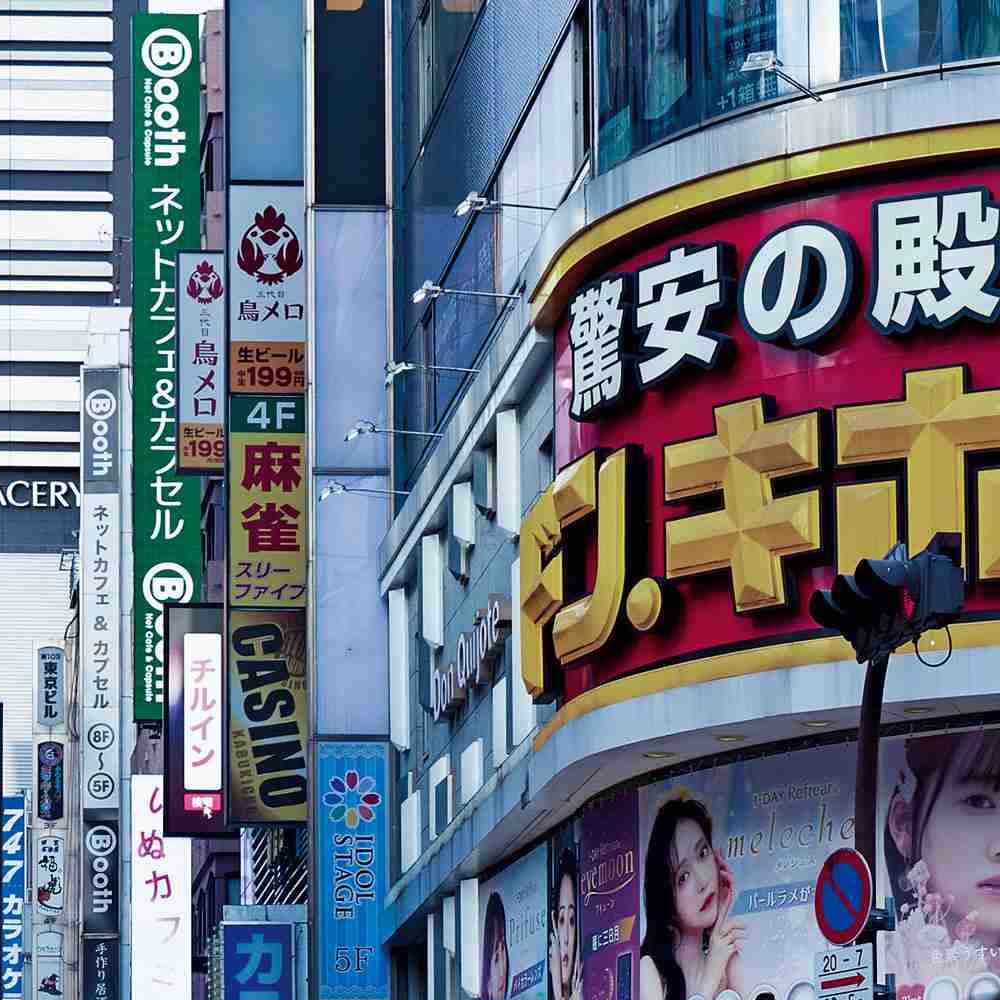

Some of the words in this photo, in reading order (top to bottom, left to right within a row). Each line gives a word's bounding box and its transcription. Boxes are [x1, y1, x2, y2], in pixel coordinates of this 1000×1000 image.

[141, 28, 193, 167] Booth
[237, 300, 304, 322] 鳥メロ
[570, 191, 1000, 420] 驚安の殿
[192, 340, 218, 417] 鳥メロ
[237, 347, 304, 363] 生ビール
[85, 389, 117, 476] Booth
[246, 401, 296, 429] 4F
[241, 441, 302, 552] 麻雀
[92, 504, 110, 606] ネットカフェ
[235, 562, 291, 578] スリー
[44, 661, 57, 719] 東京ビル
[93, 640, 110, 709] カプセル
[92, 730, 109, 744] 8F
[190, 658, 216, 767] チルイン
[232, 624, 307, 808] CASINO
[92, 779, 109, 792] 5F
[86, 825, 117, 913] Booth
[333, 836, 353, 921] STAGE
[354, 836, 374, 904] IDOL
[335, 946, 374, 974] 5F
